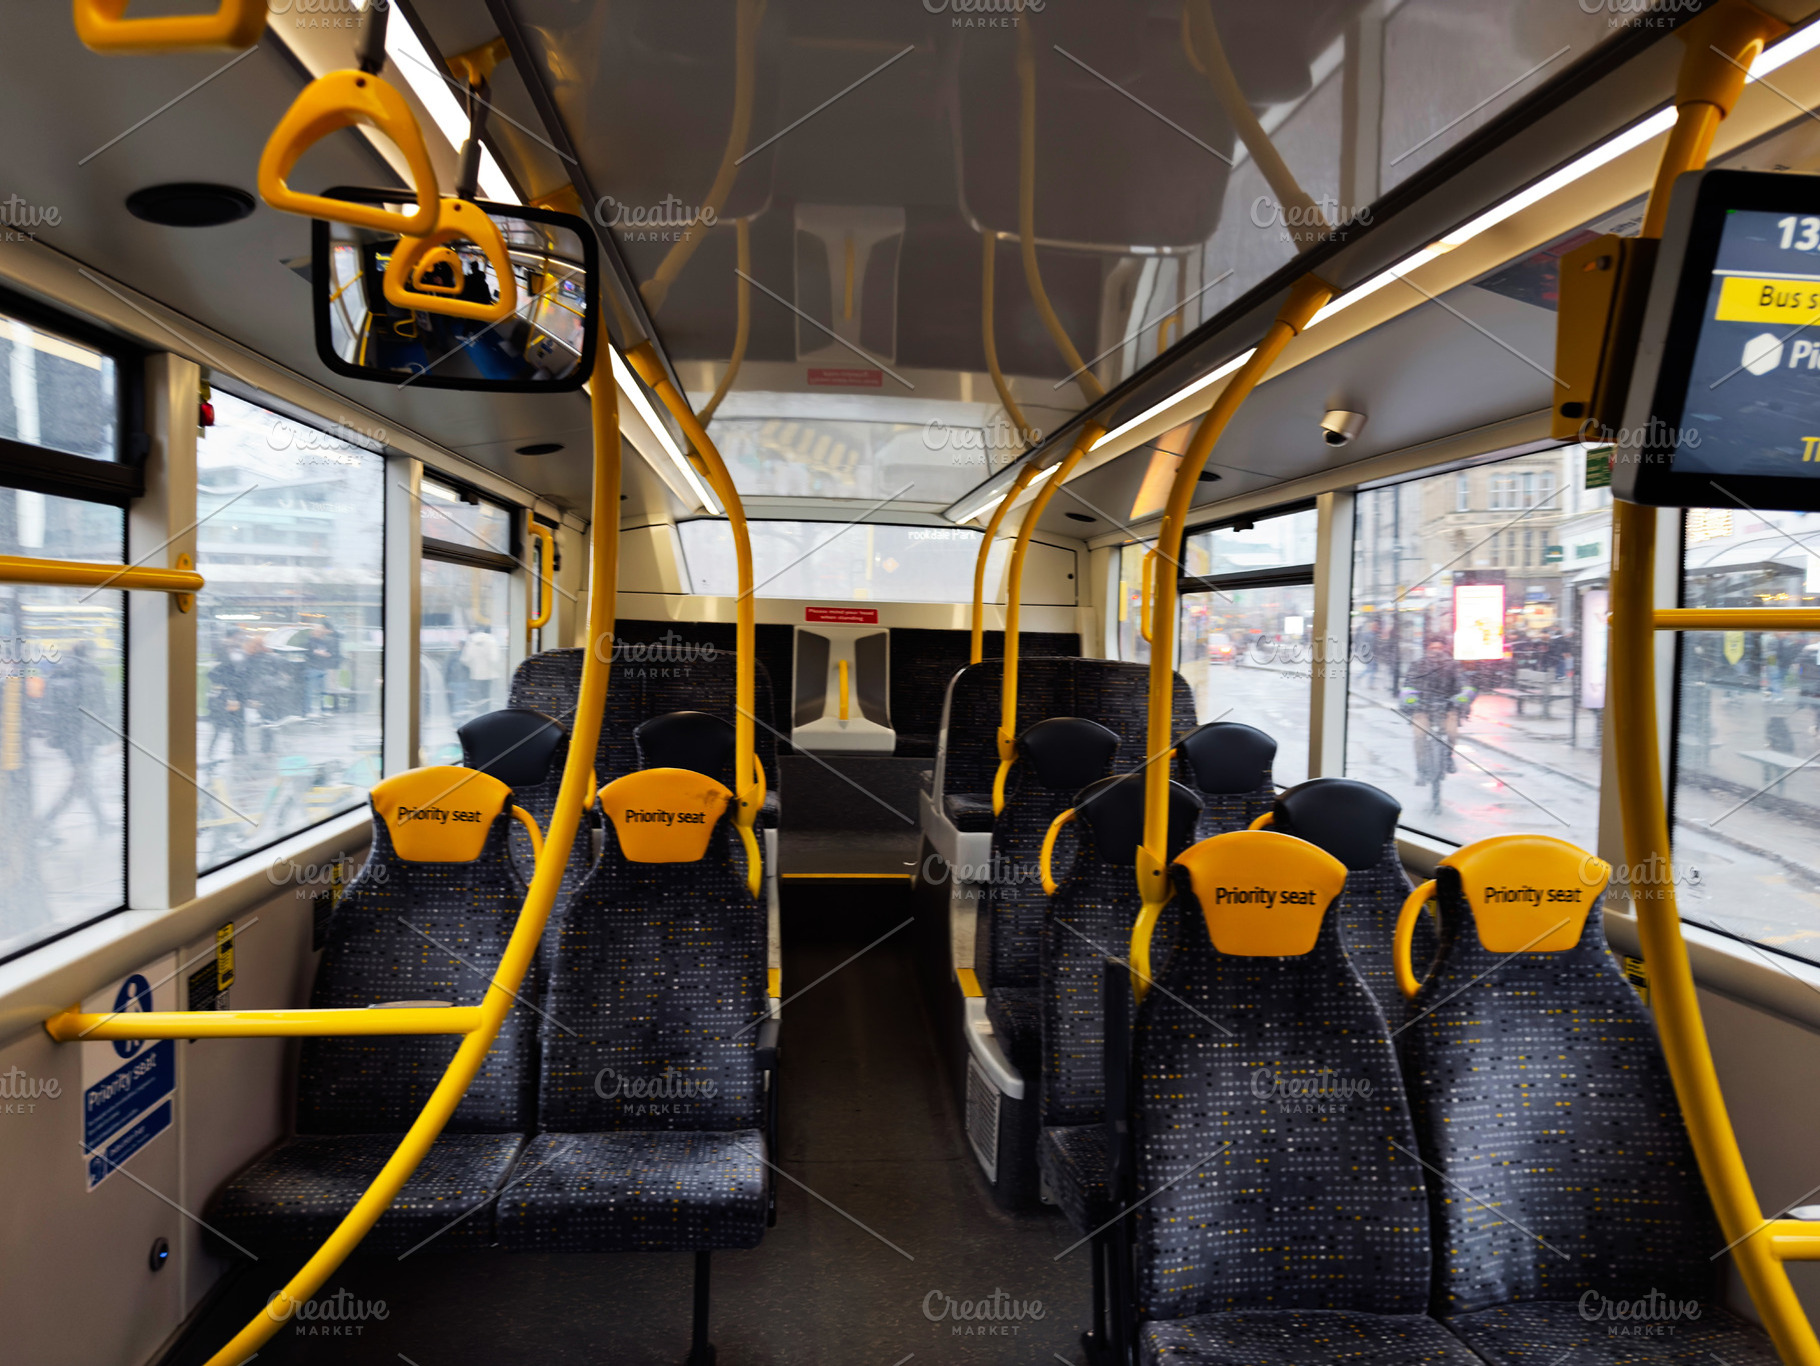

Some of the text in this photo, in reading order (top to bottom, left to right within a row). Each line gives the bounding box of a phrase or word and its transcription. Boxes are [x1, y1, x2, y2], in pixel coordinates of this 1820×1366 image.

[1778, 216, 1820, 251] 13
[1760, 285, 1801, 309] Bus
[1788, 340, 1820, 369] Pi
[1801, 436, 1820, 462] T
[398, 806, 482, 825] Priority seat
[625, 809, 706, 827] Priority seat
[1215, 887, 1317, 909] Priority seat
[1484, 885, 1582, 907] Priority seat
[88, 1071, 132, 1112] Priority
[133, 1053, 156, 1080] seat
